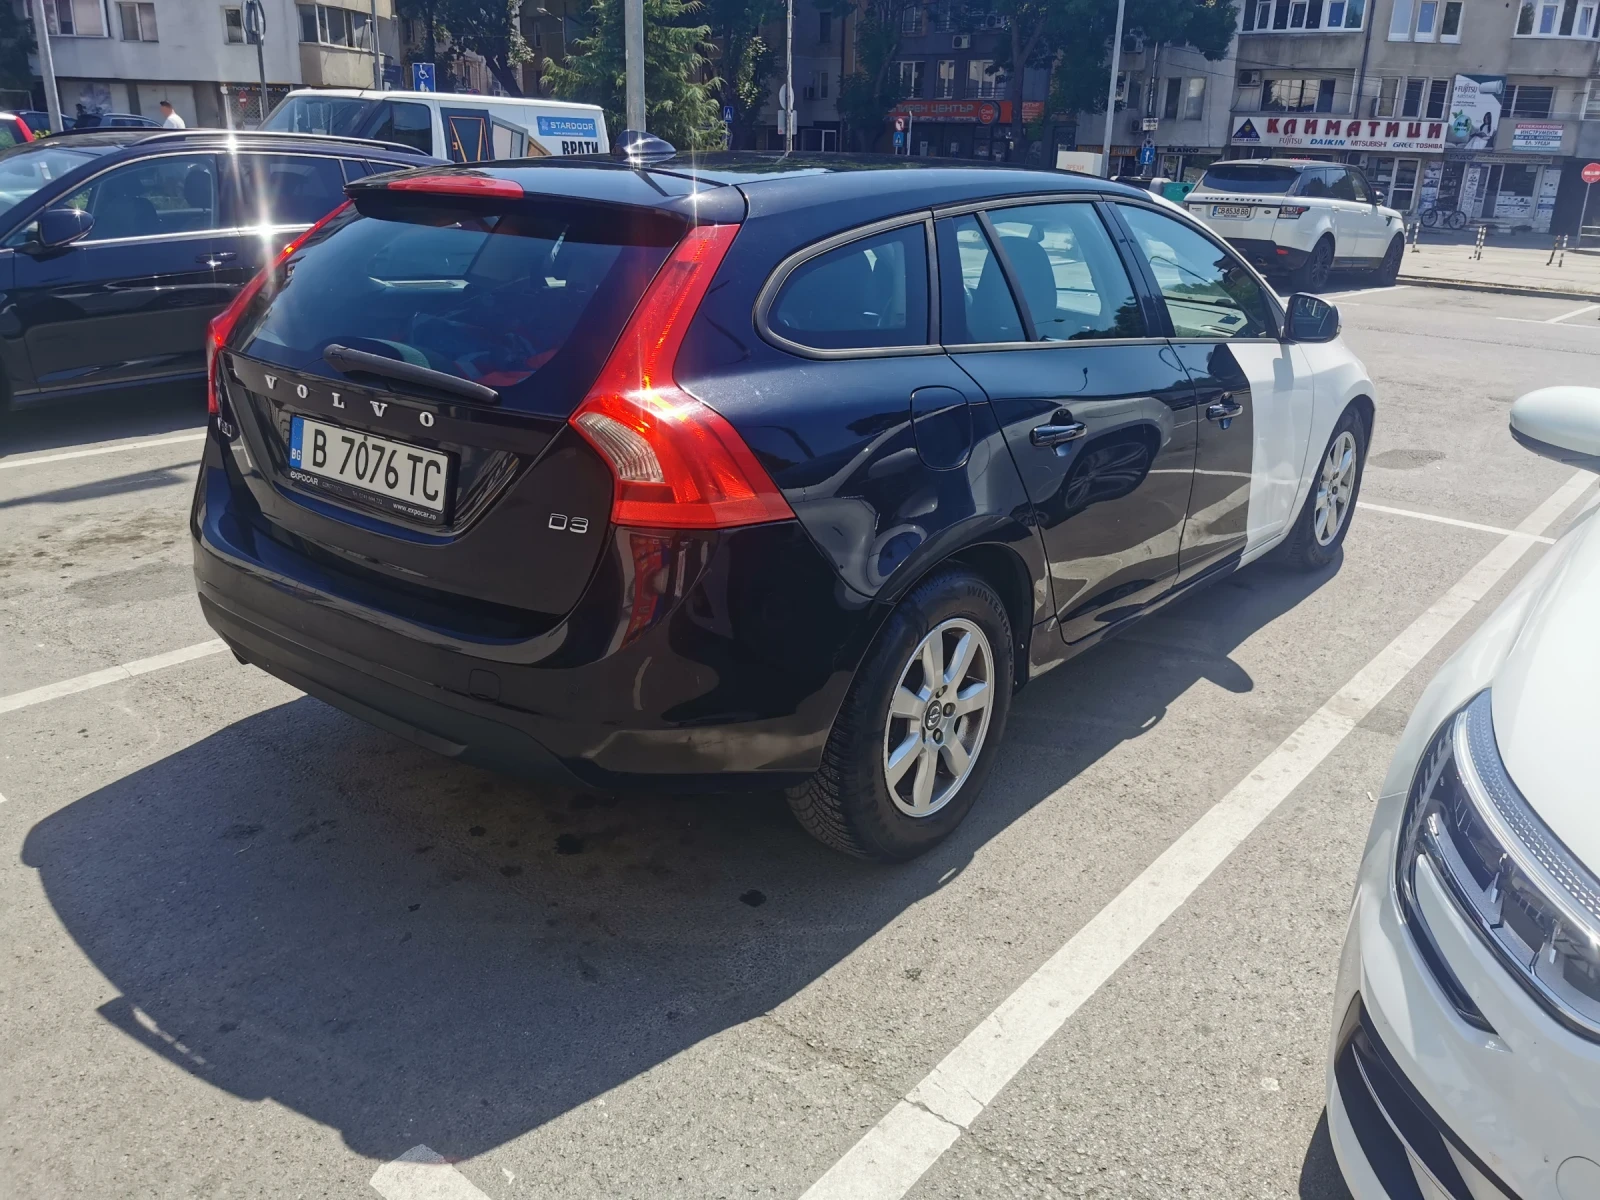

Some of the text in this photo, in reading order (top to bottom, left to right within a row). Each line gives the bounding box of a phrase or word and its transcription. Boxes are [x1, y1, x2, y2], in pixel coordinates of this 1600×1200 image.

[550, 121, 594, 130] STARDOOR
[1266, 118, 1443, 139] КЛИМАТИЦИ
[1279, 136, 1302, 145] FUJITSU
[1309, 138, 1346, 146] DAIKIN
[1350, 140, 1388, 148] MITSUBISHI
[263, 374, 436, 428] VOLVO
[291, 447, 302, 461] BG
[311, 430, 439, 502] B 7076 TC
[392, 502, 437, 520] www.expocar.ro
[547, 512, 589, 534] D3
